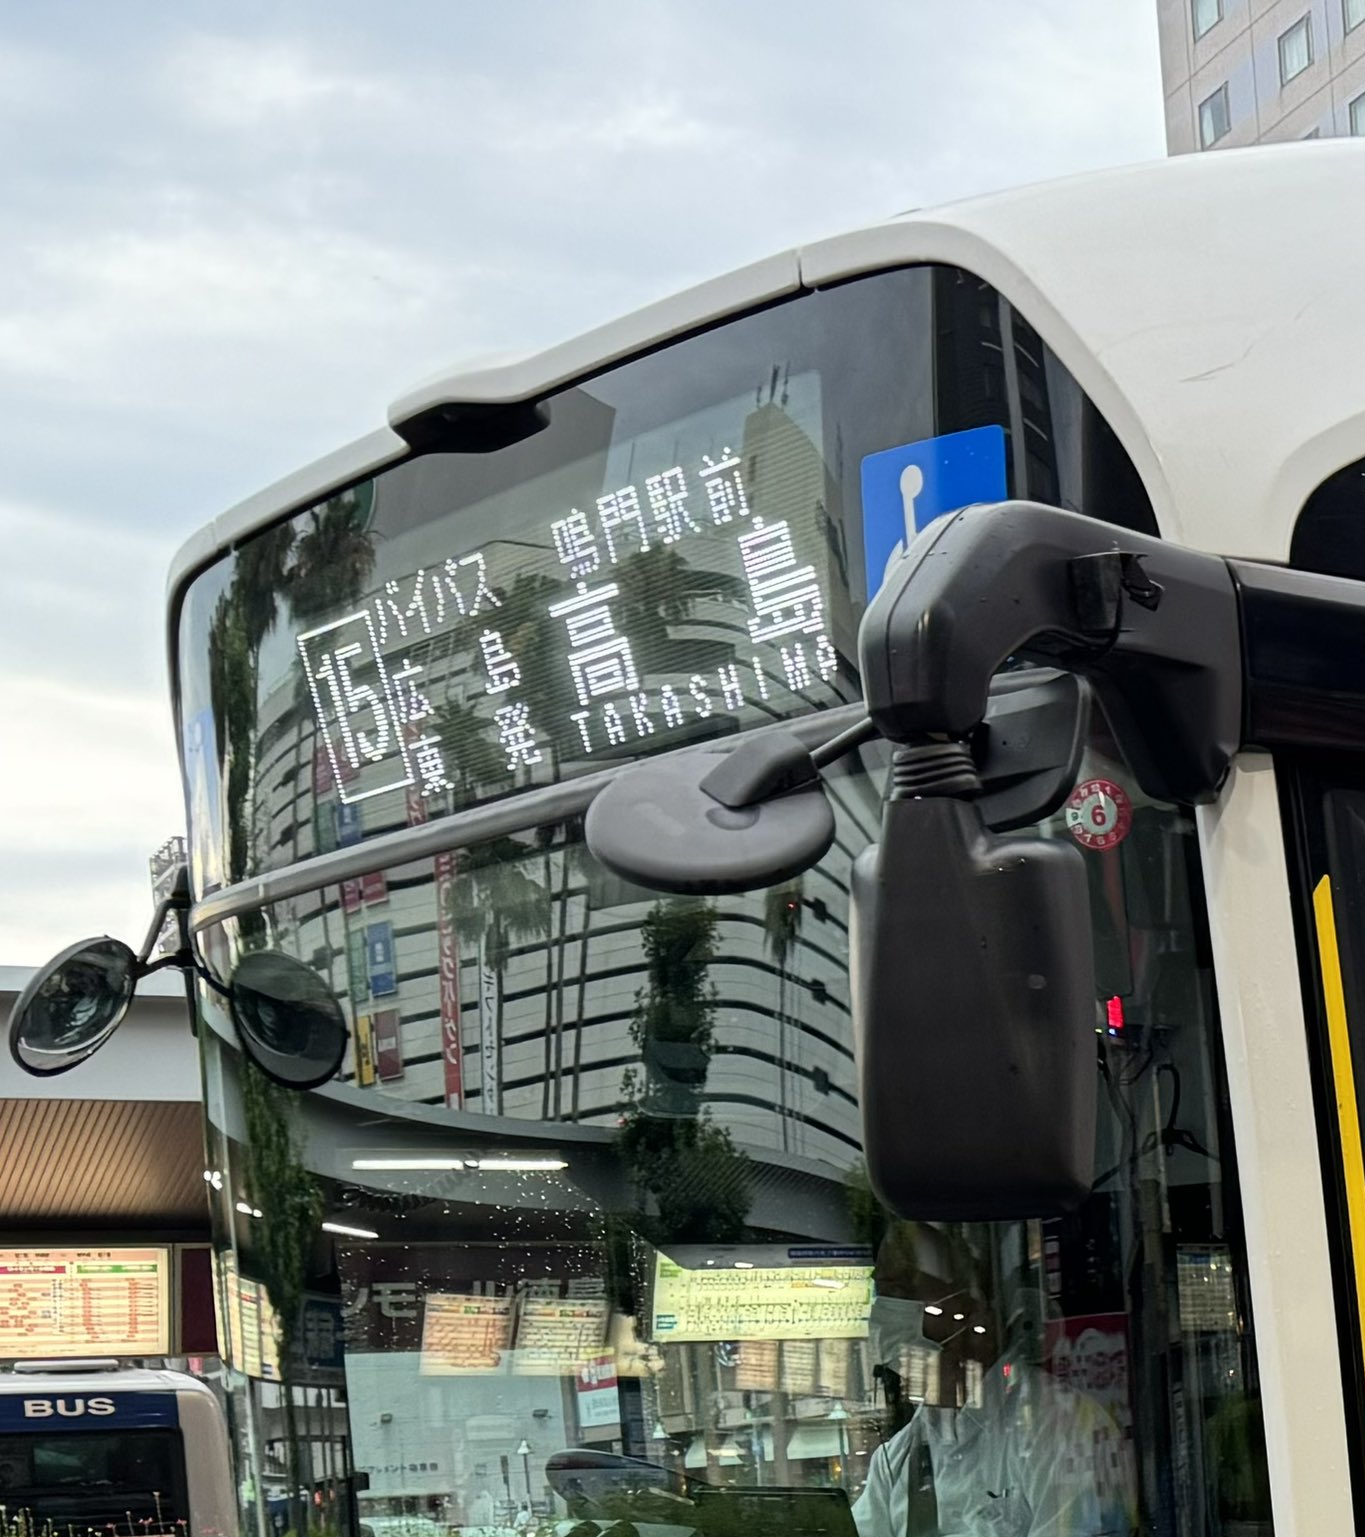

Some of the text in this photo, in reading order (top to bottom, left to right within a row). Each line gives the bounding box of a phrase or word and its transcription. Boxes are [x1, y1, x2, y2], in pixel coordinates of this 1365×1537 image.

[550, 447, 751, 579] 鳴門駅前
[372, 554, 502, 644] バイパス
[549, 516, 829, 706] 高島
[314, 641, 391, 762] 15
[570, 634, 841, 753] TAKASHIMA
[24, 1397, 116, 1419] BUS
